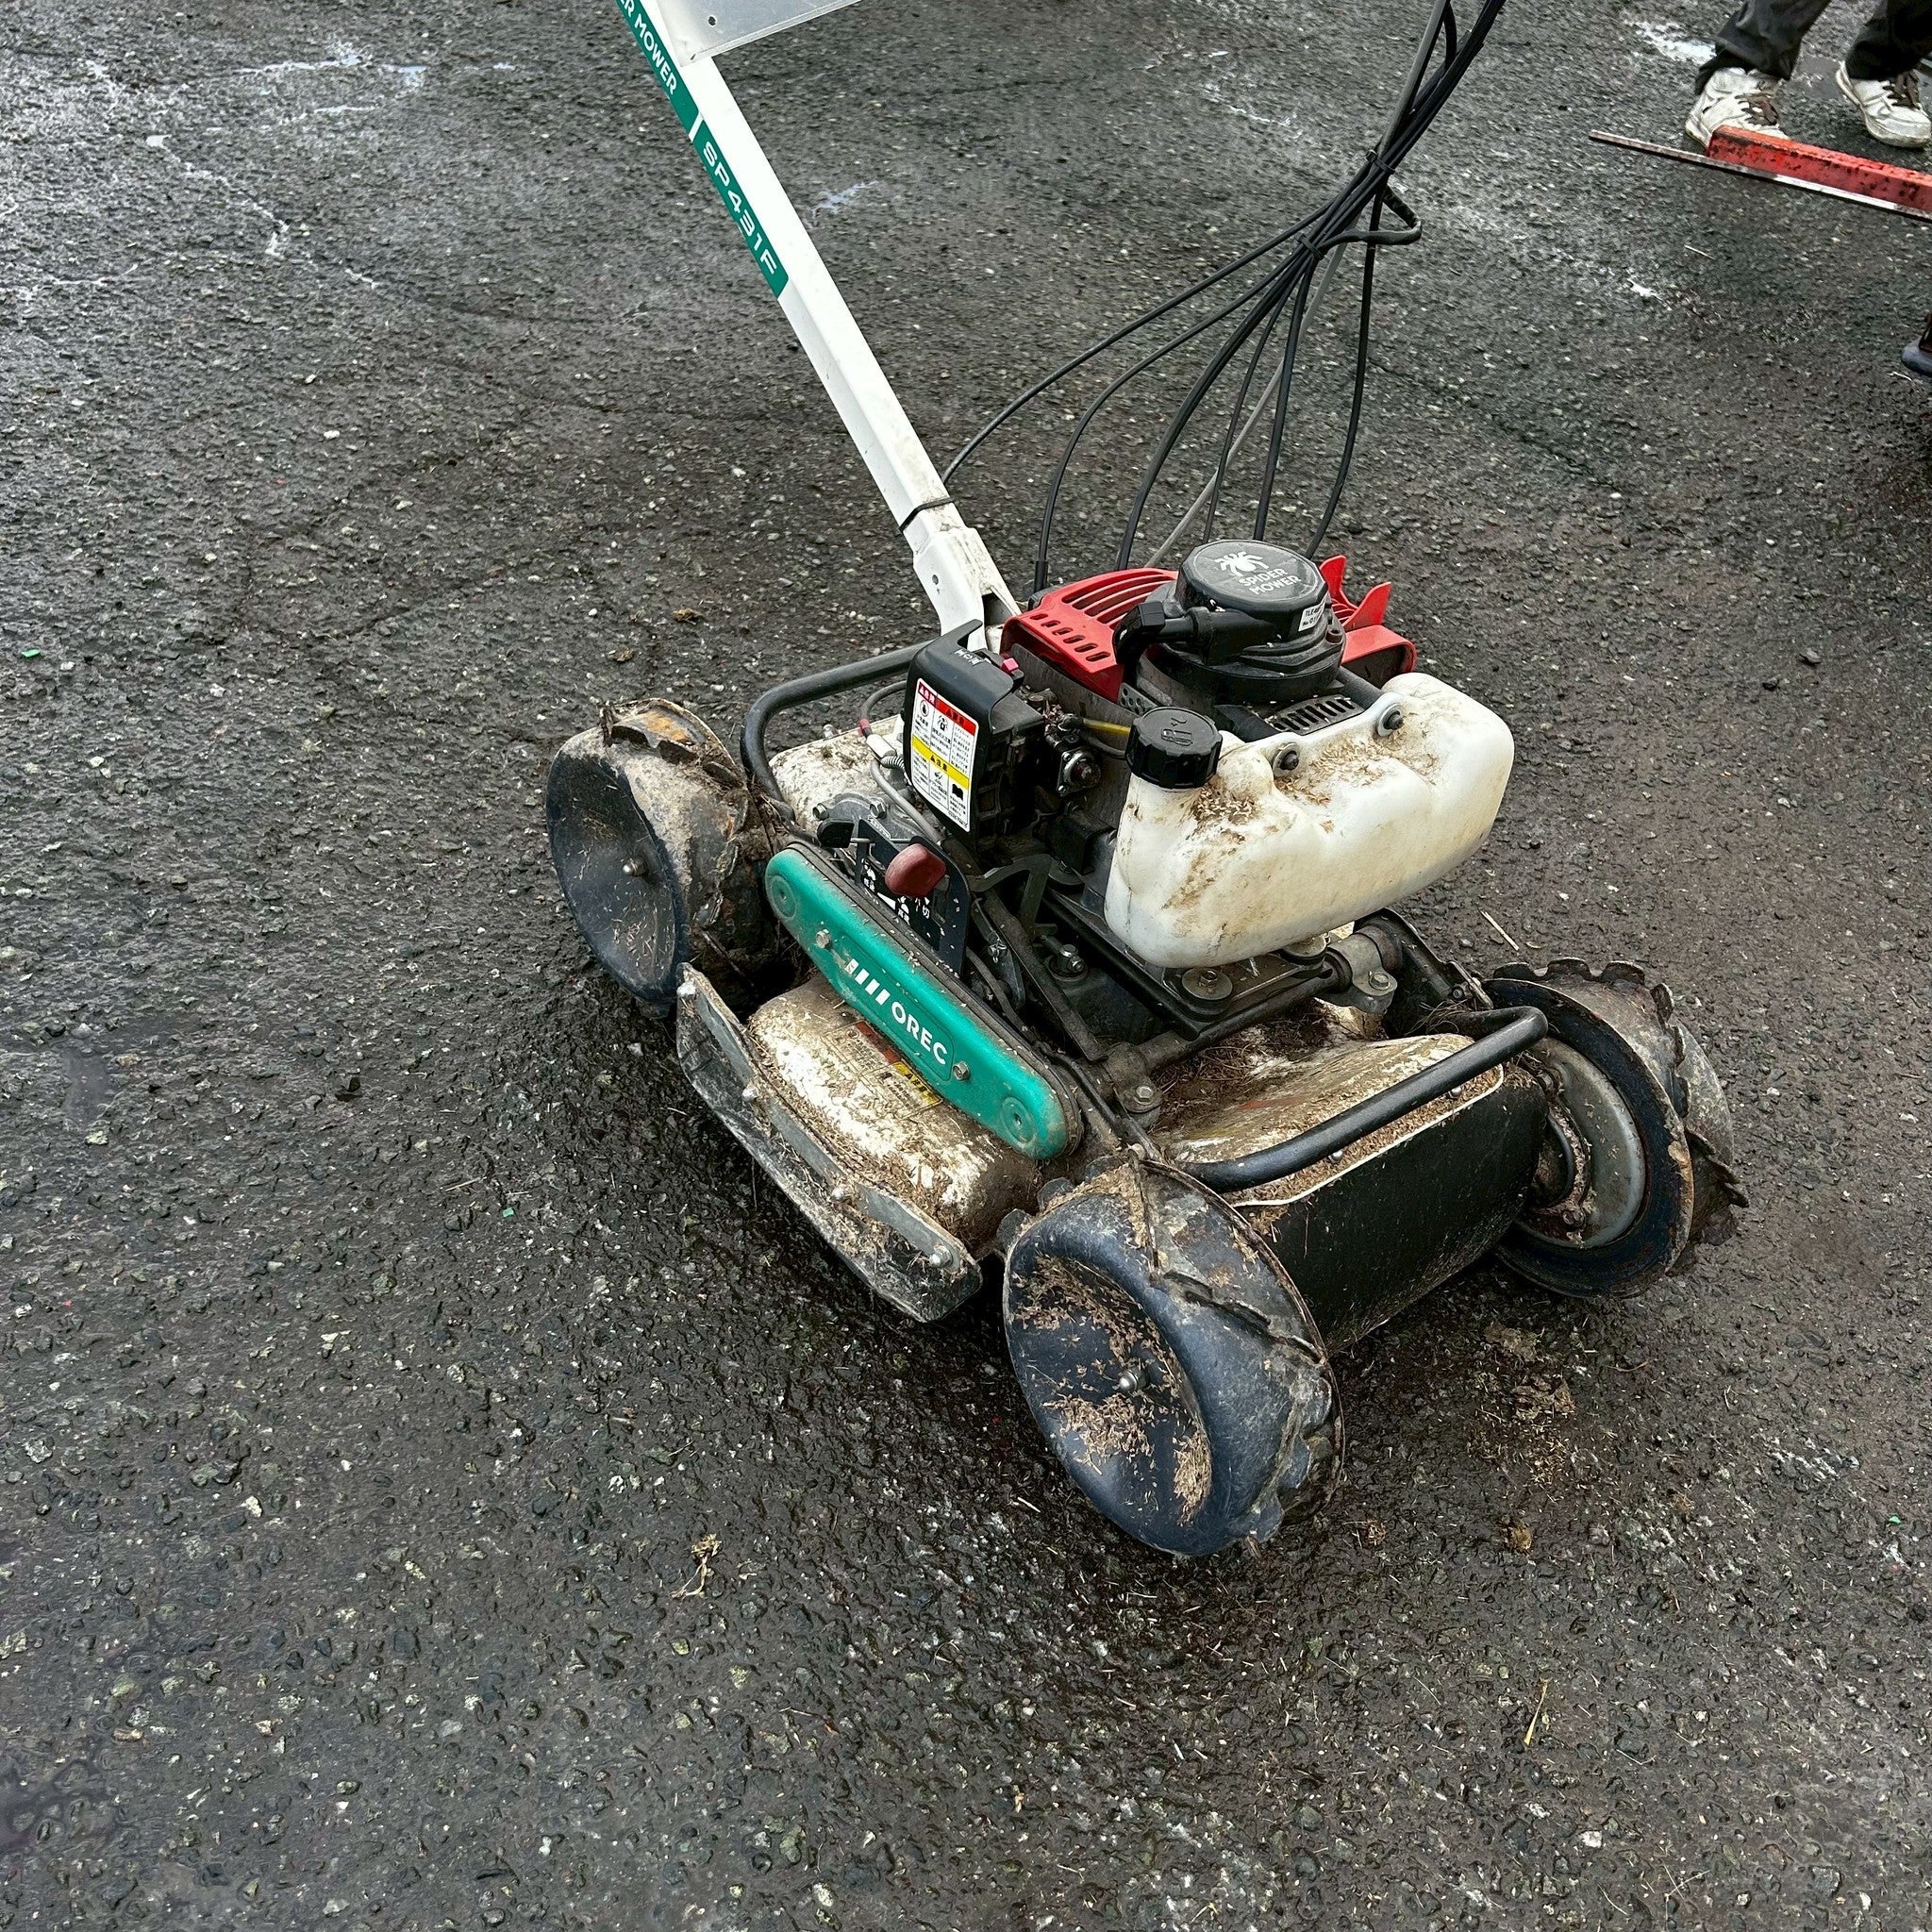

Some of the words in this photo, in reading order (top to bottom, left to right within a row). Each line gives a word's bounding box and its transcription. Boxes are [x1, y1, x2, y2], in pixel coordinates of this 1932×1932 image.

[634, 13, 677, 95] MOWER
[703, 142, 777, 275] SP431F
[1239, 568, 1289, 587] SPIDER
[1249, 575, 1302, 595] MOWER
[891, 1001, 948, 1065] OREC
